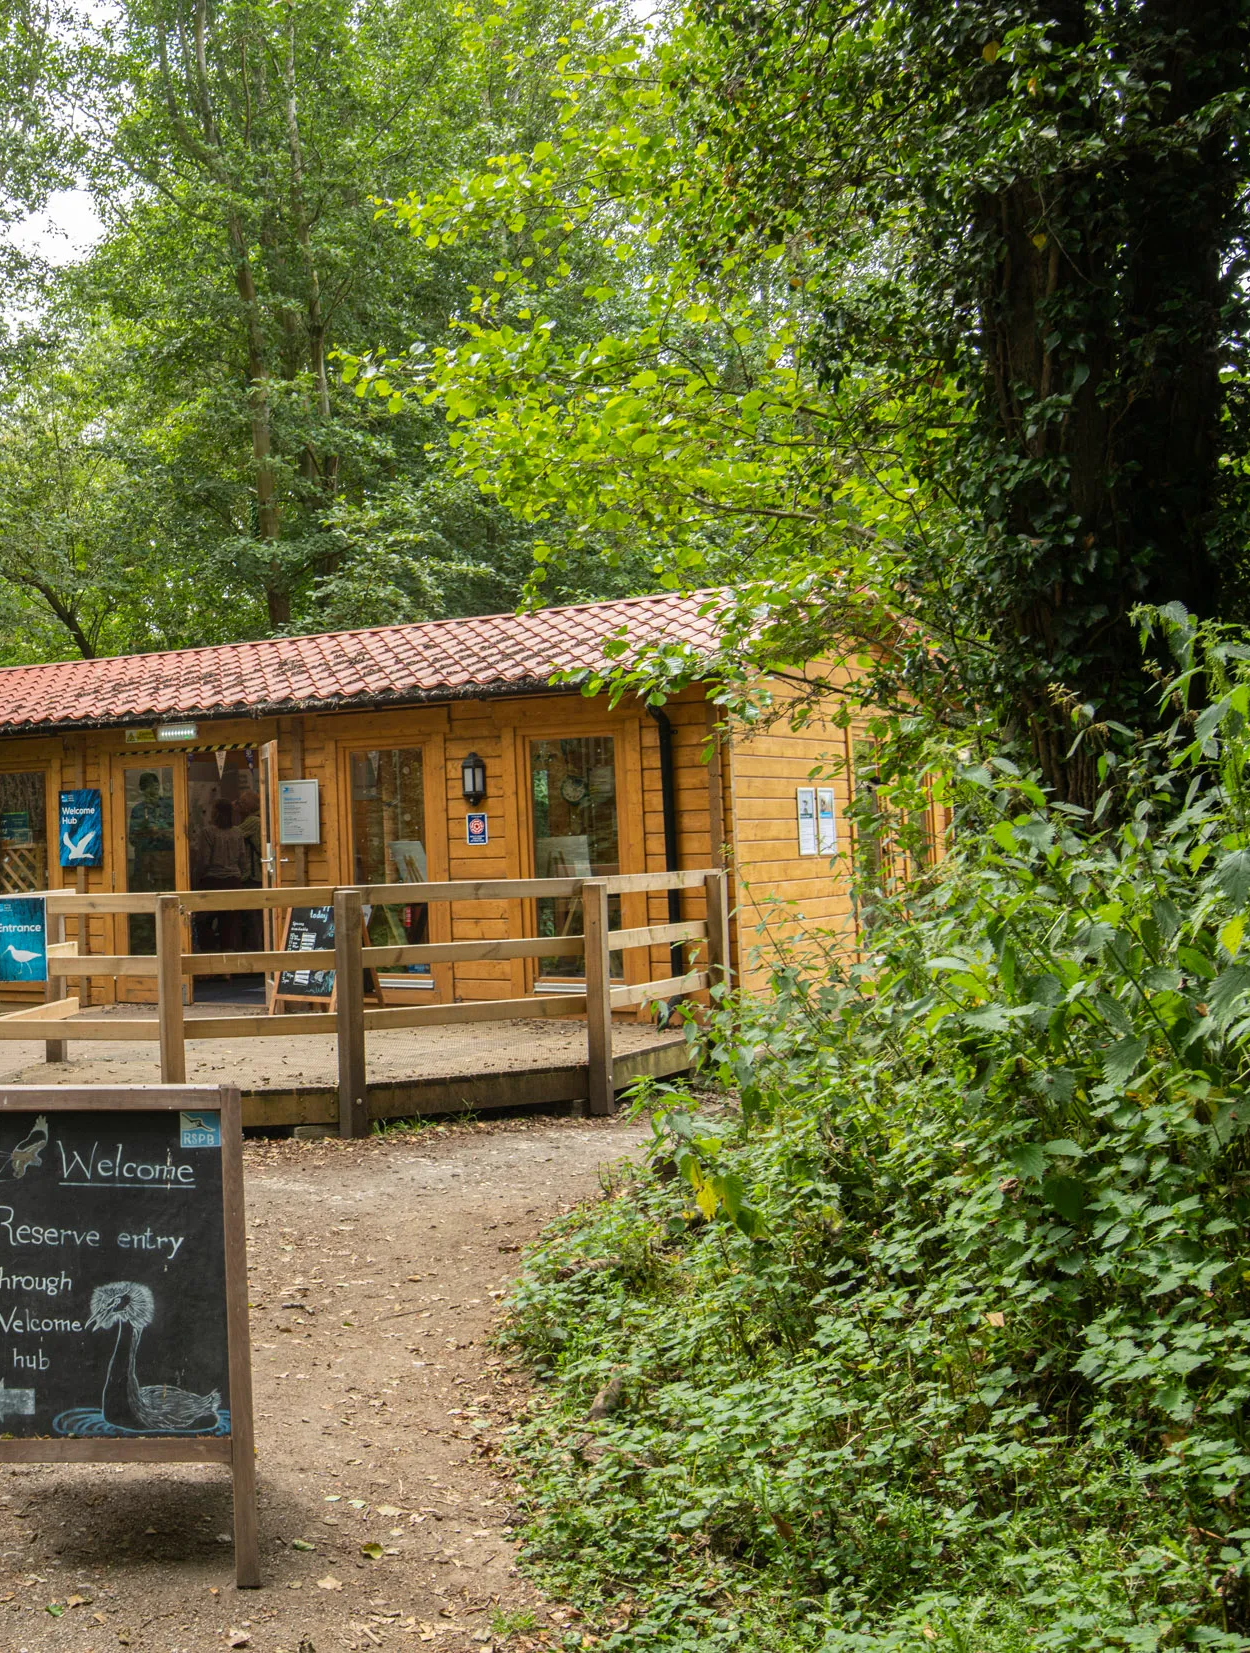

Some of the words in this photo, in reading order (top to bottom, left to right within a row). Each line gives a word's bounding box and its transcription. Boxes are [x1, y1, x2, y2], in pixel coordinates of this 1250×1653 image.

[61, 807, 95, 815] Welcome
[61, 816, 78, 825] Hub
[310, 909, 328, 923] today
[183, 1132, 215, 1145] RSPB
[56, 1140, 196, 1182] Welcome
[117, 1227, 184, 1259] entry
[13, 1348, 50, 1371] hub
